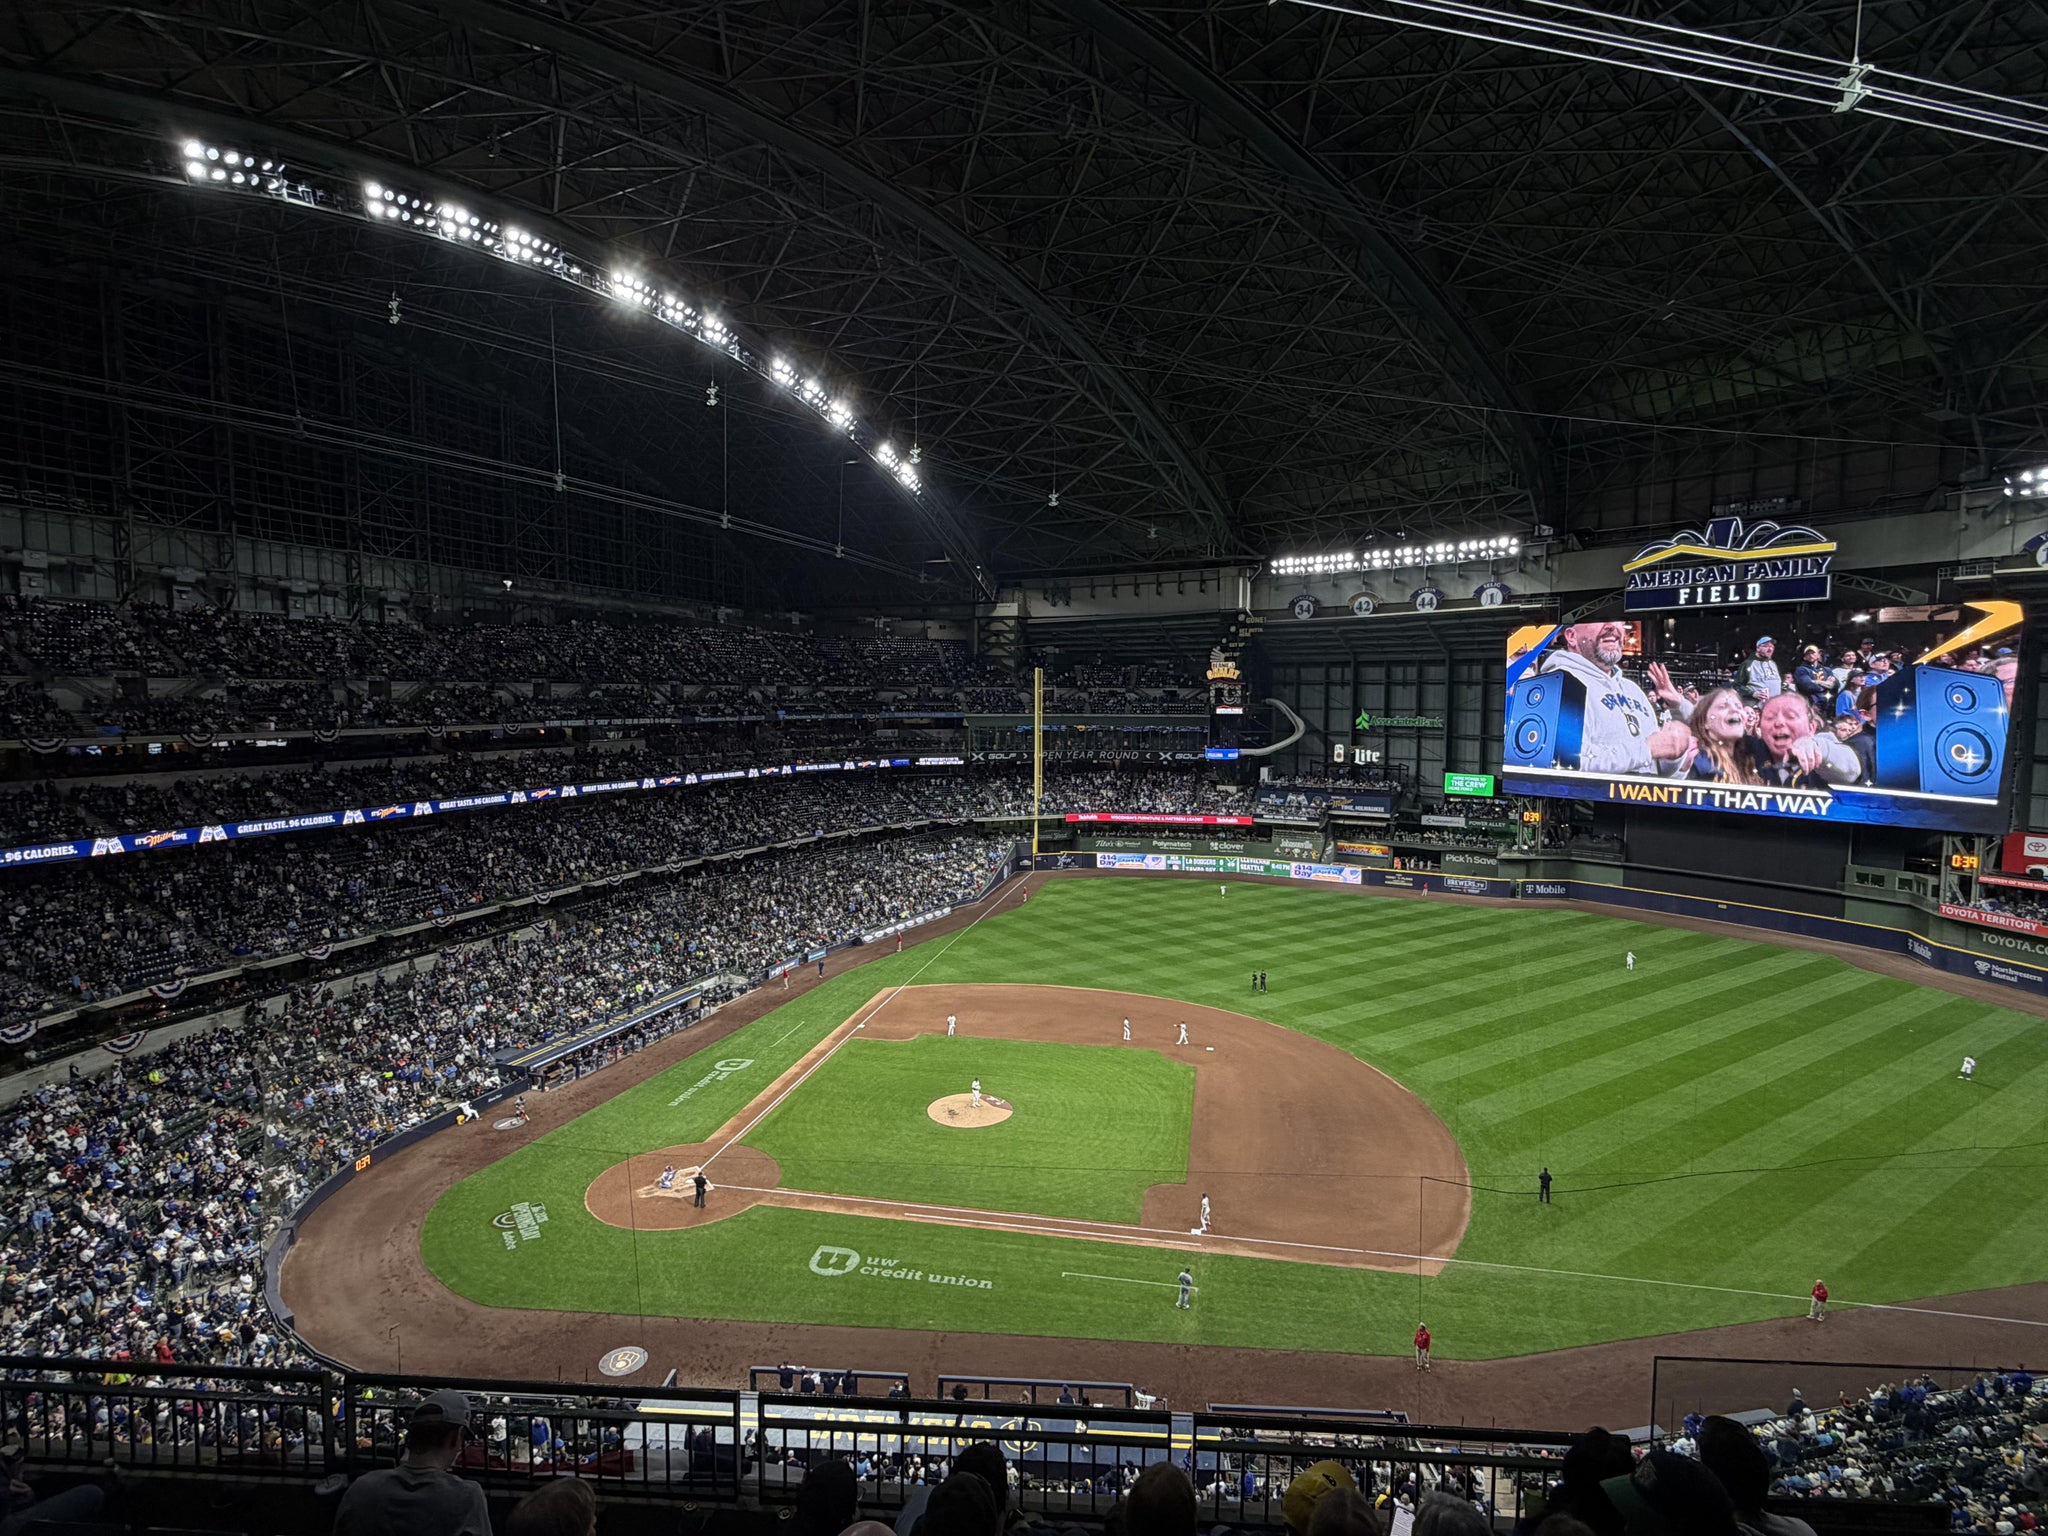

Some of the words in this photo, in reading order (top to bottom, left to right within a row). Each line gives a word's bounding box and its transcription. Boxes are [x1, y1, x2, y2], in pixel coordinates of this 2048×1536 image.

[1627, 566, 1736, 589] AMERICAN
[1743, 556, 1832, 580] FAMILY
[1679, 583, 1761, 605] FIELD
[1356, 601, 1371, 612] 42
[1418, 597, 1434, 608] 44
[1297, 605, 1311, 615] 34
[988, 752, 1017, 760] GOLF
[1066, 750, 1094, 760] YEAR
[1099, 750, 1139, 760] ROUND
[1354, 748, 1380, 765] Lite
[1609, 783, 1615, 799] I
[1619, 783, 1682, 803] WANT
[1686, 788, 1708, 806] IT
[1710, 790, 1773, 811] THAT
[1776, 794, 1833, 815] WAY
[1523, 812, 1540, 822] 0:39
[237, 824, 262, 834] GREAT
[263, 821, 289, 832] TASTE.
[289, 819, 300, 828] 96
[300, 815, 336, 826] CALORIES.
[145, 831, 177, 848] Miller
[1152, 840, 1192, 848] Polymatech
[1218, 841, 1244, 850] clover
[5, 852, 22, 863] 96
[23, 845, 78, 861] CALORIES.
[1445, 853, 1464, 863] Pick
[1473, 855, 1498, 866] Save
[1951, 854, 1979, 869] 0:39
[1240, 864, 1264, 872] SEATTLE
[1535, 884, 1566, 895] Mobile
[1940, 905, 1979, 920] TOYOTA
[1979, 912, 2038, 931] TERRITORY
[1991, 964, 2043, 982] Northwestern
[1991, 970, 2018, 982] Mutual
[866, 1256, 899, 1267] uw
[859, 1265, 924, 1281] credit
[928, 1274, 993, 1290] union
